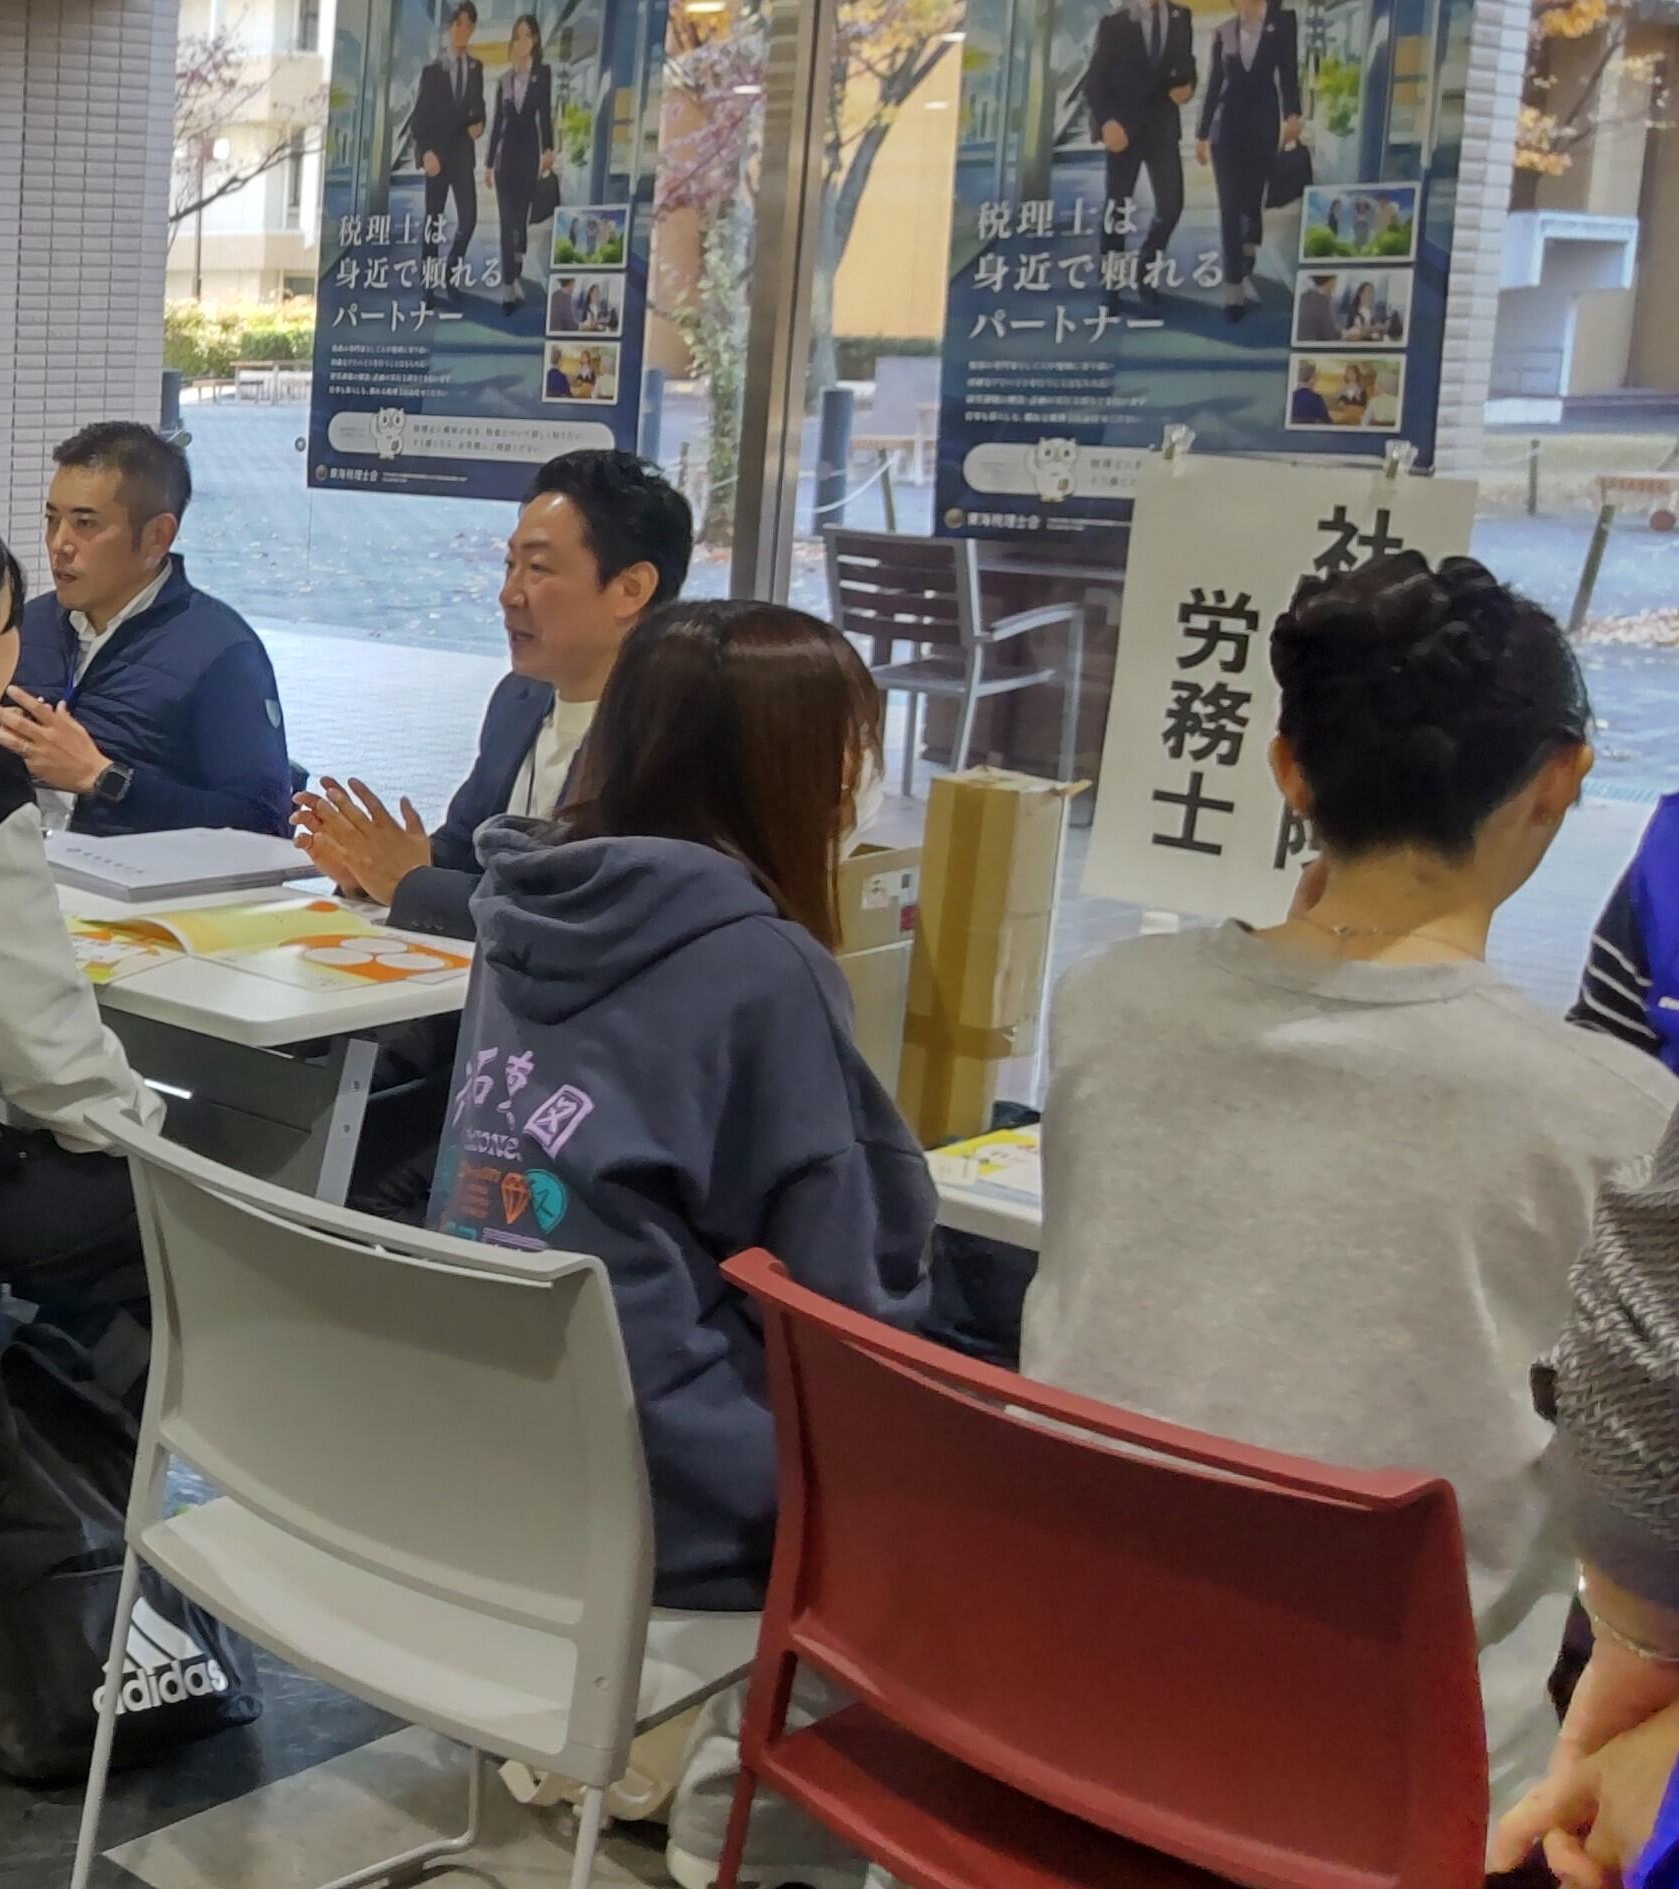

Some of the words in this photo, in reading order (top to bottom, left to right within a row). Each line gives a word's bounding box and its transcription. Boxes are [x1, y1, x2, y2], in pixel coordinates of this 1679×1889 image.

[338, 213, 448, 248] 税理士は
[978, 197, 1139, 240] 税理士は
[335, 255, 503, 290] 身近で頼れる
[973, 250, 1224, 293] 身近で頼れる
[331, 300, 464, 333] パートナー
[969, 305, 1165, 344] パートナー
[1151, 587, 1260, 856] 労務士
